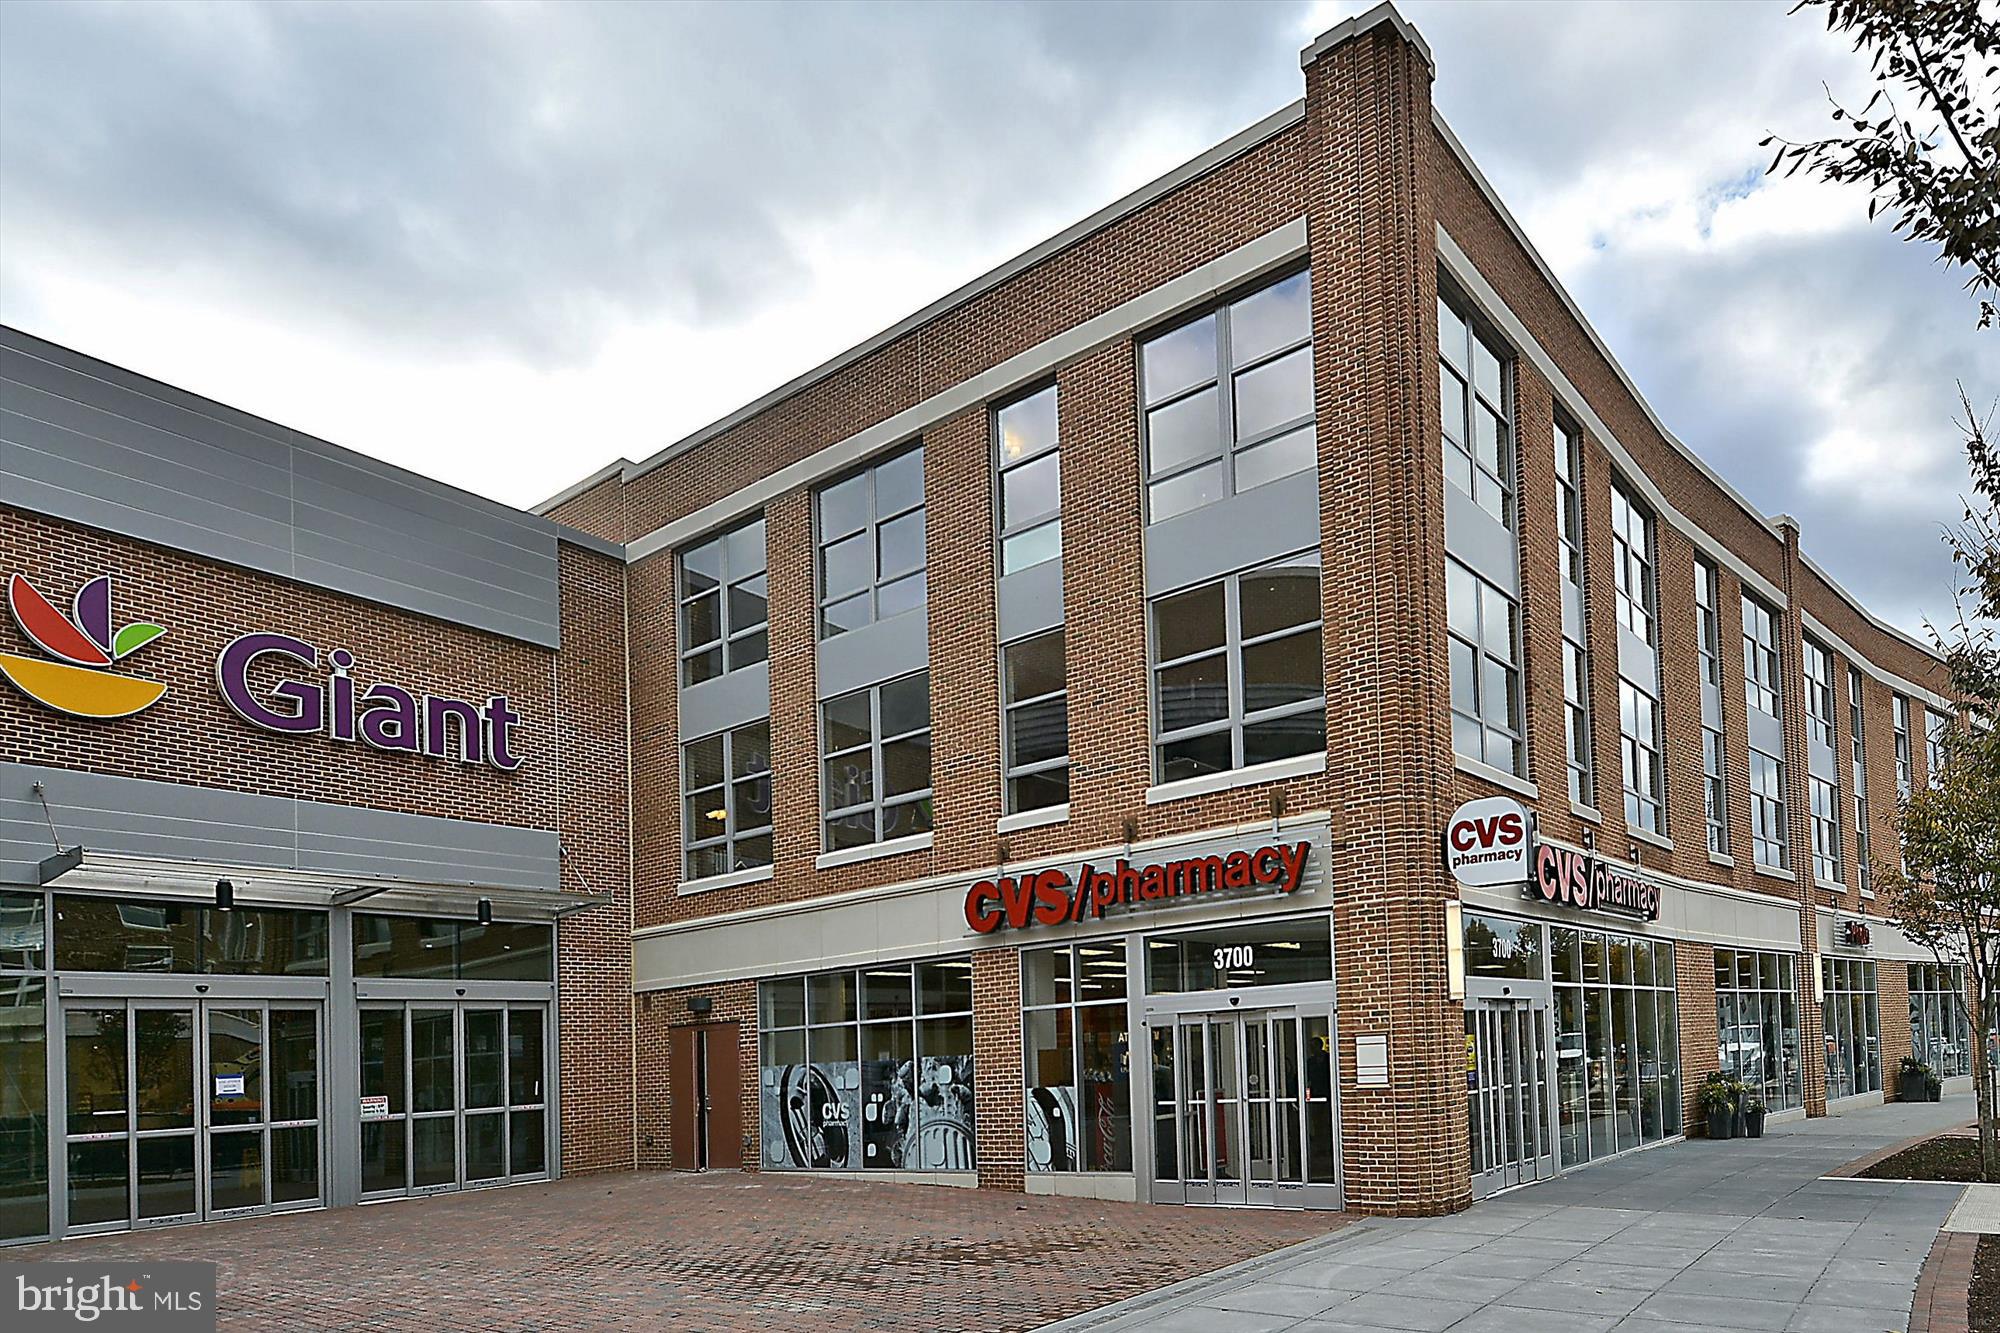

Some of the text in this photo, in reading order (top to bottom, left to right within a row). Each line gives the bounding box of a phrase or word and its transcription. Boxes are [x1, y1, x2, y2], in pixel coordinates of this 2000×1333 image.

[215, 632, 525, 770] Giant
[1451, 813, 1524, 851] CVS
[1452, 848, 1523, 870] pharmacy
[964, 841, 1312, 934] CVS/pharmacy
[1537, 844, 1662, 921] CVS/pharmacy
[1213, 945, 1253, 970] 3700
[1491, 937, 1511, 959] 3700
[822, 1102, 850, 1119] CVS
